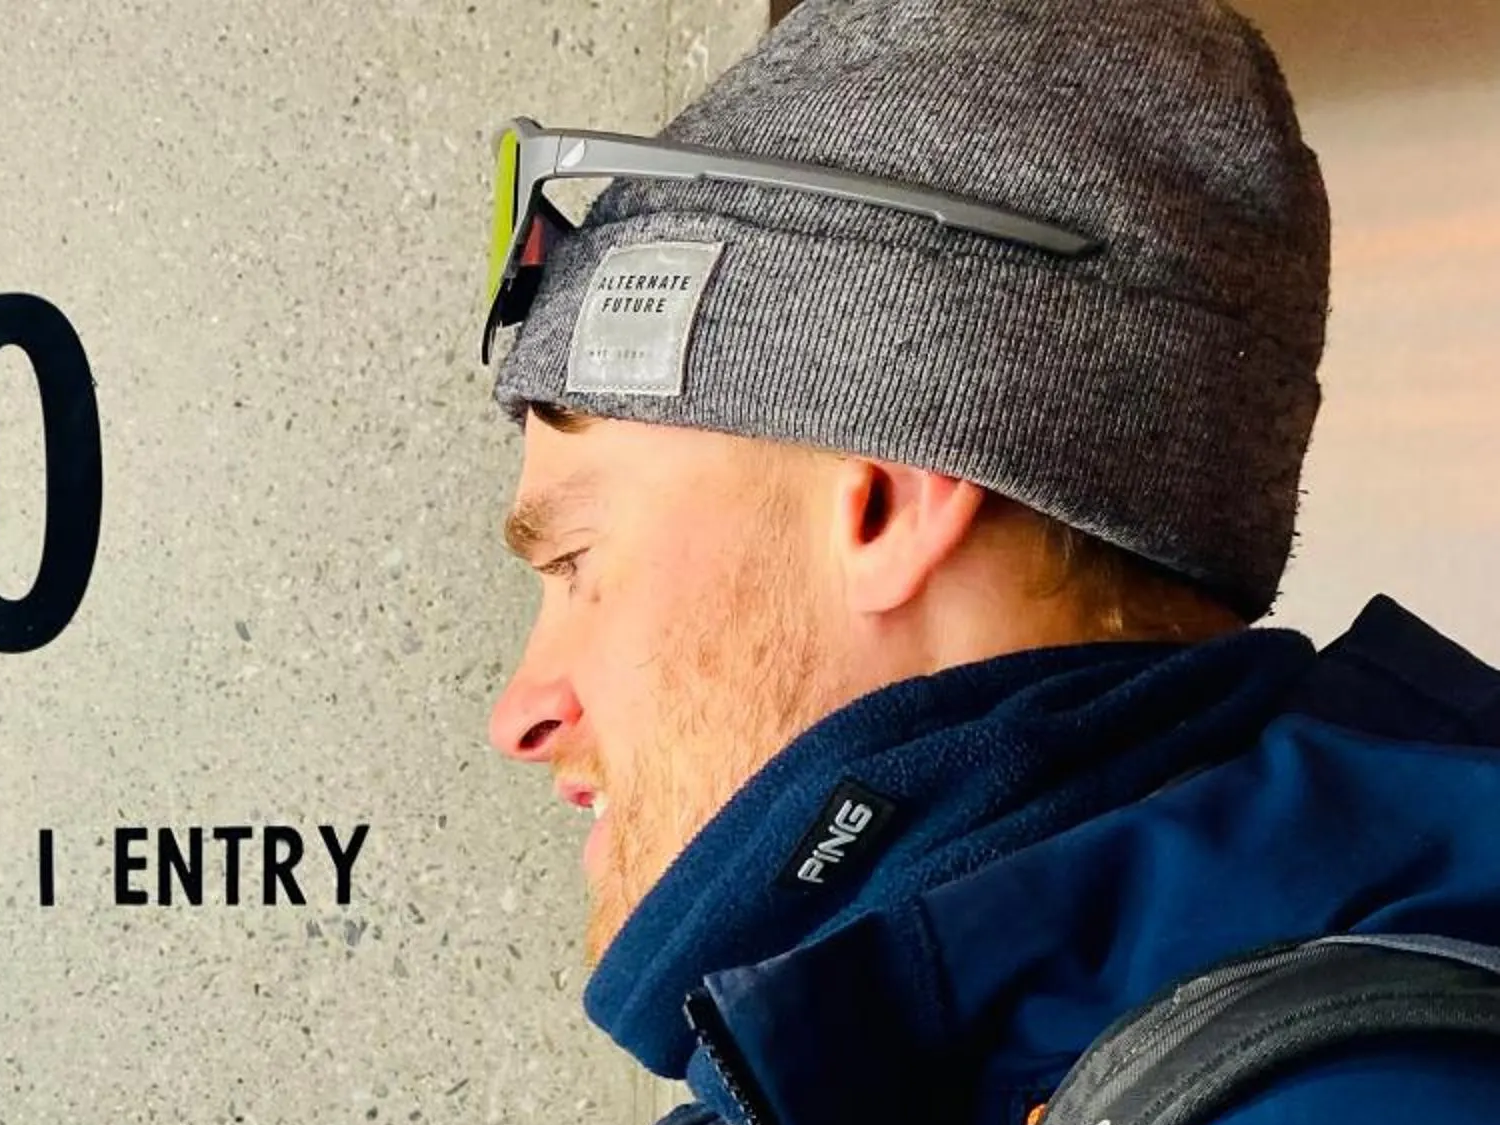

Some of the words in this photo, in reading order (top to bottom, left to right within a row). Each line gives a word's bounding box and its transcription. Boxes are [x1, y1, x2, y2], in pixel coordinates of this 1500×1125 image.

[599, 274, 692, 292] ALTERNATE
[601, 297, 665, 314] FUTURE
[115, 824, 370, 906] ENTRY
[797, 799, 873, 883] PING
